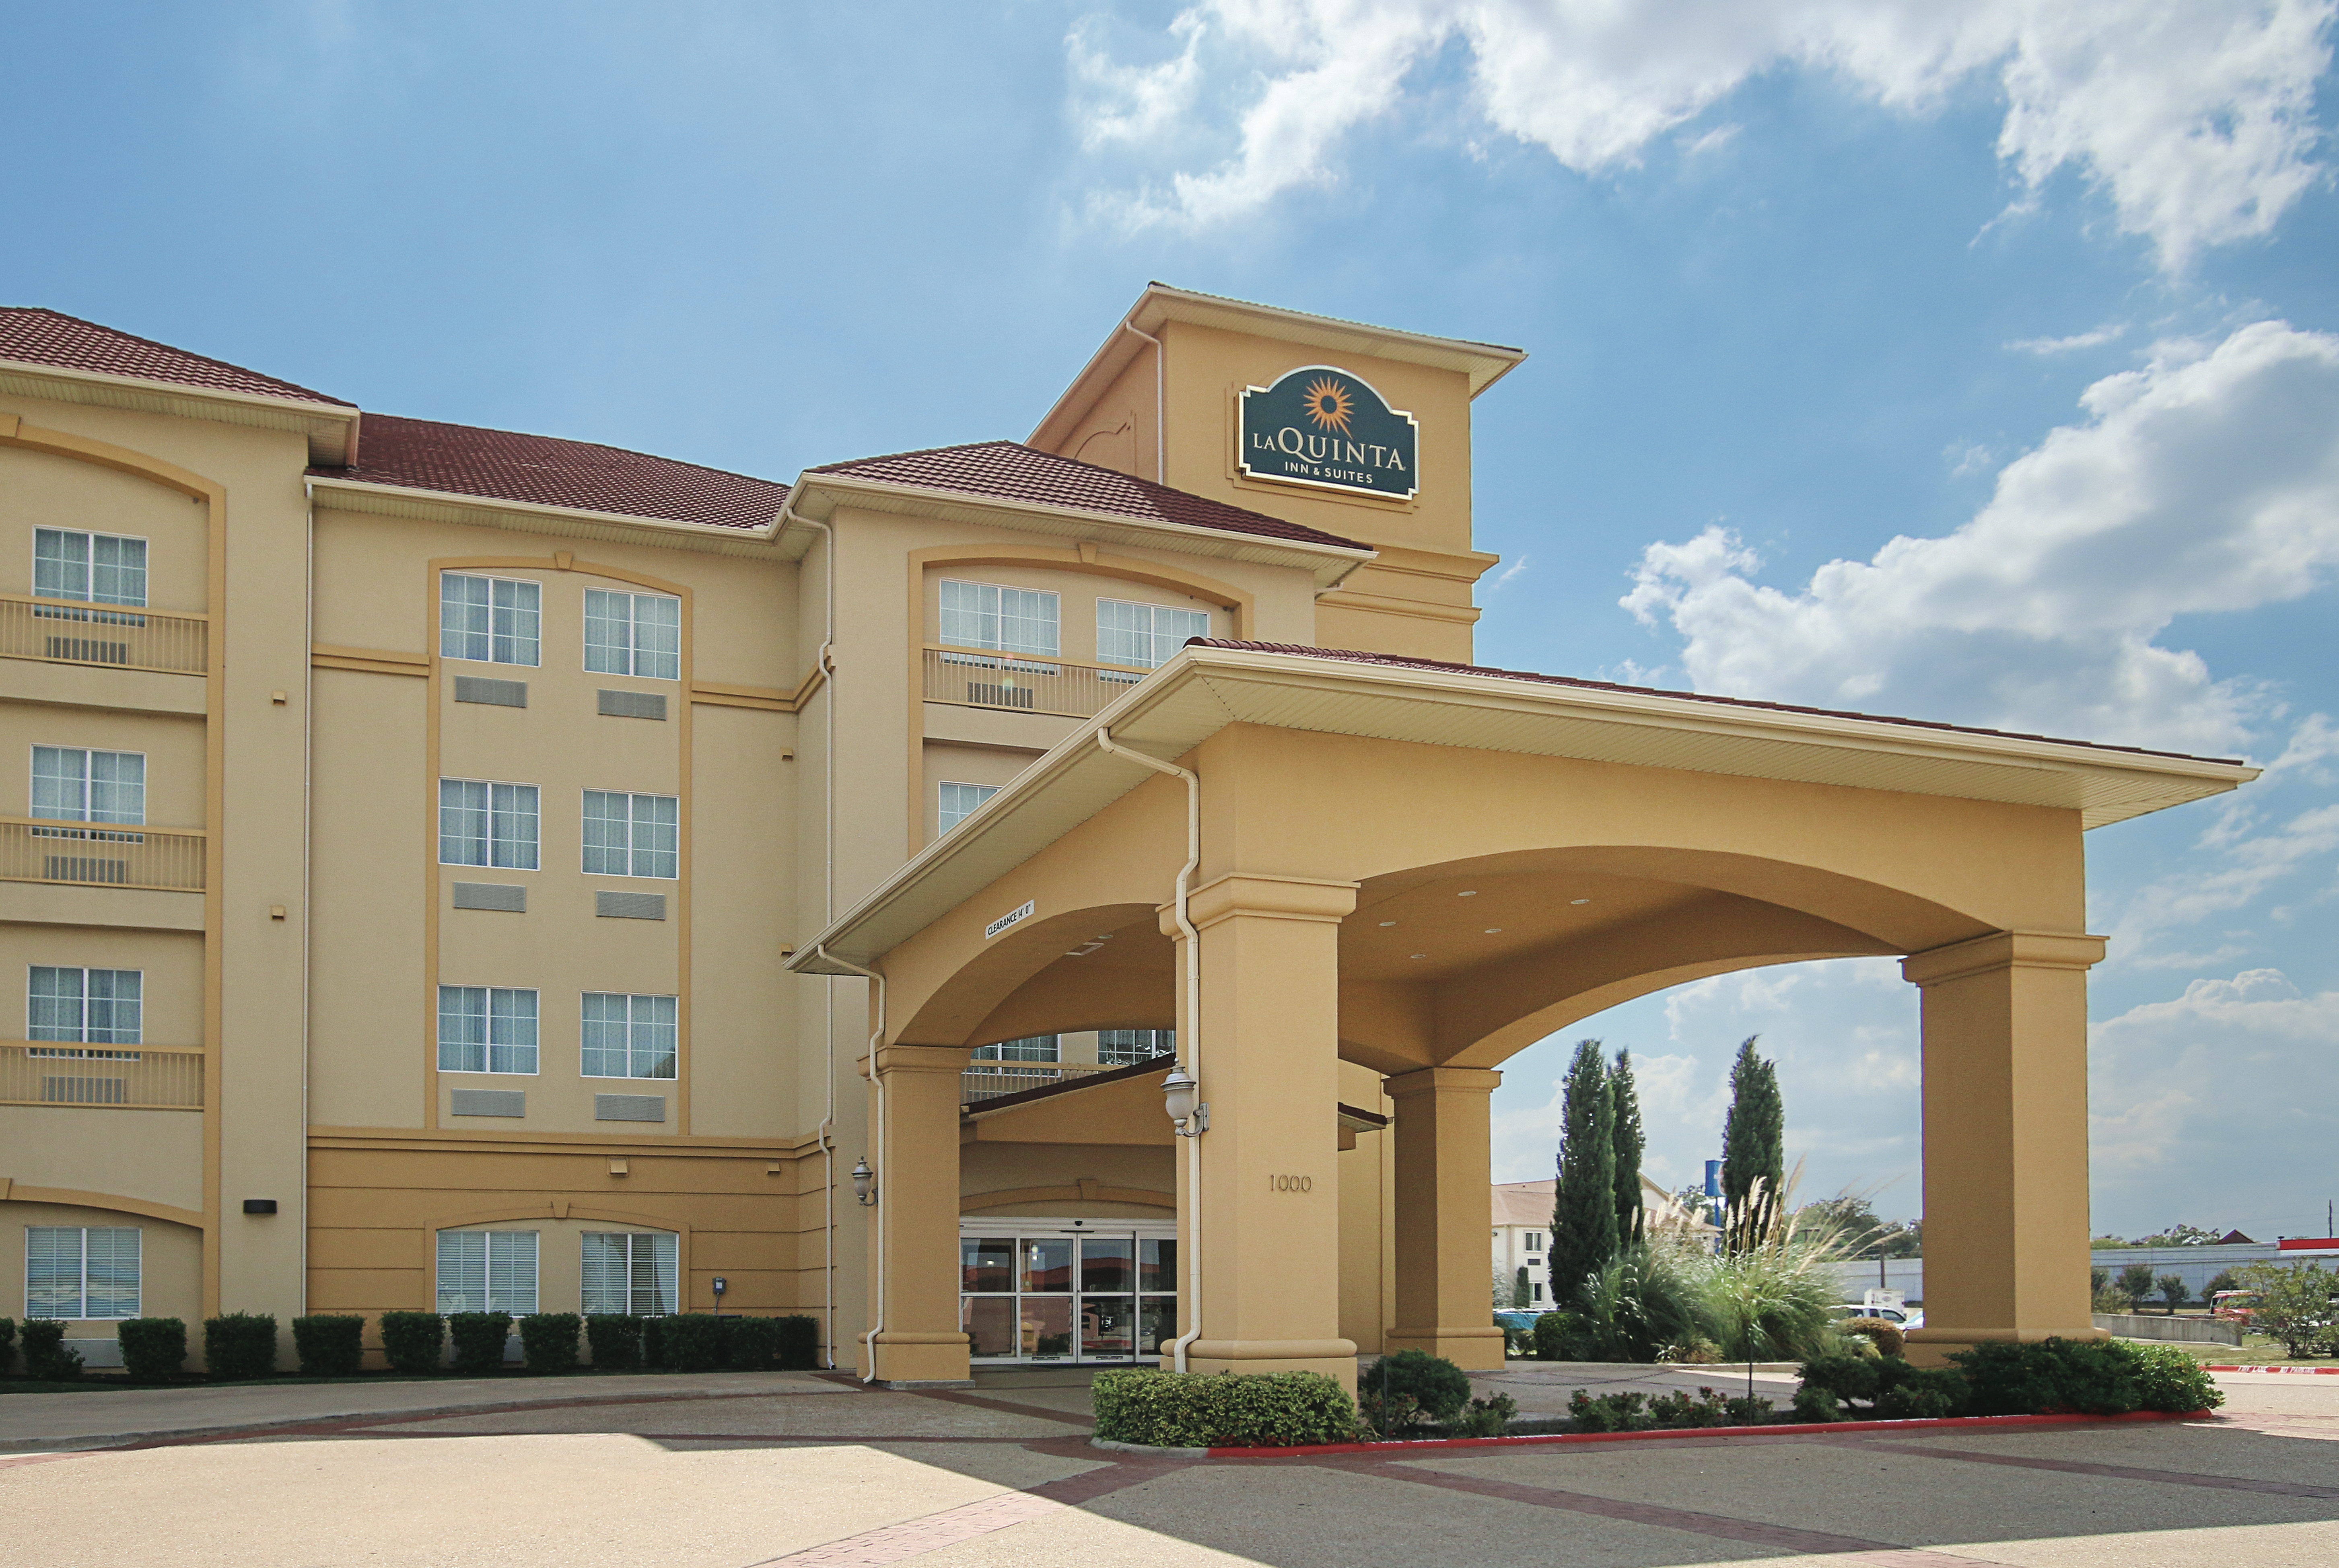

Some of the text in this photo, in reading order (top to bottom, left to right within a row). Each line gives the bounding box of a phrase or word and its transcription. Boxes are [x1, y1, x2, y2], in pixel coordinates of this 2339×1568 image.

[1253, 427, 1406, 471] LA QUINTA
[1285, 461, 1373, 484] INN & SUITES
[988, 912, 1017, 935] CLEARANCE
[1270, 1174, 1312, 1192] 1000
